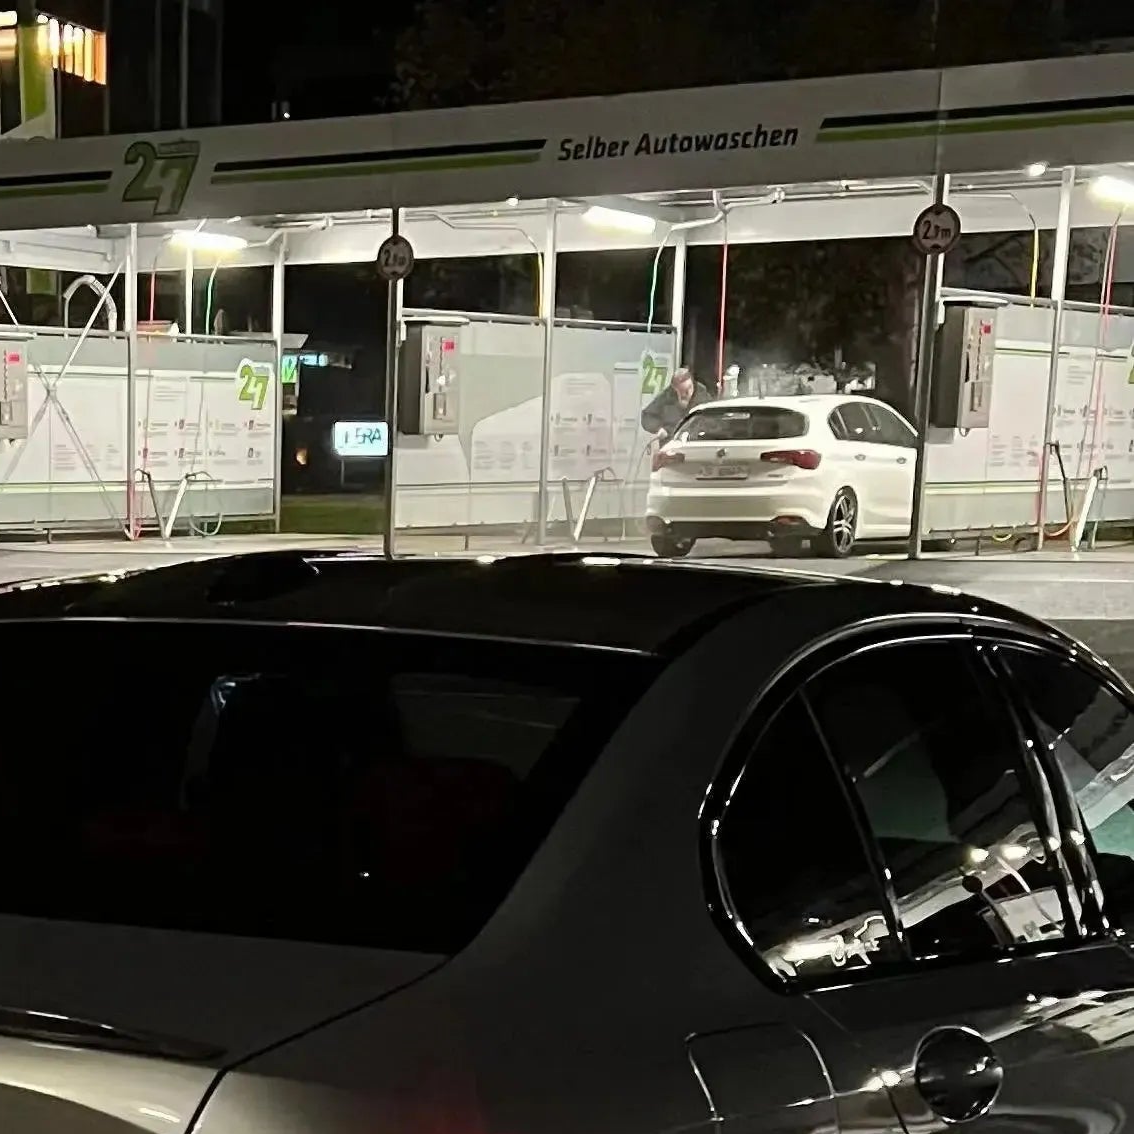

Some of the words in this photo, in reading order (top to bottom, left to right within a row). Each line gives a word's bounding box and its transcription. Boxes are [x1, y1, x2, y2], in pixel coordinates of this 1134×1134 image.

[558, 136, 630, 161] Selber
[634, 123, 799, 157] Autowaschen
[122, 139, 201, 216] 27
[238, 363, 270, 411] 27
